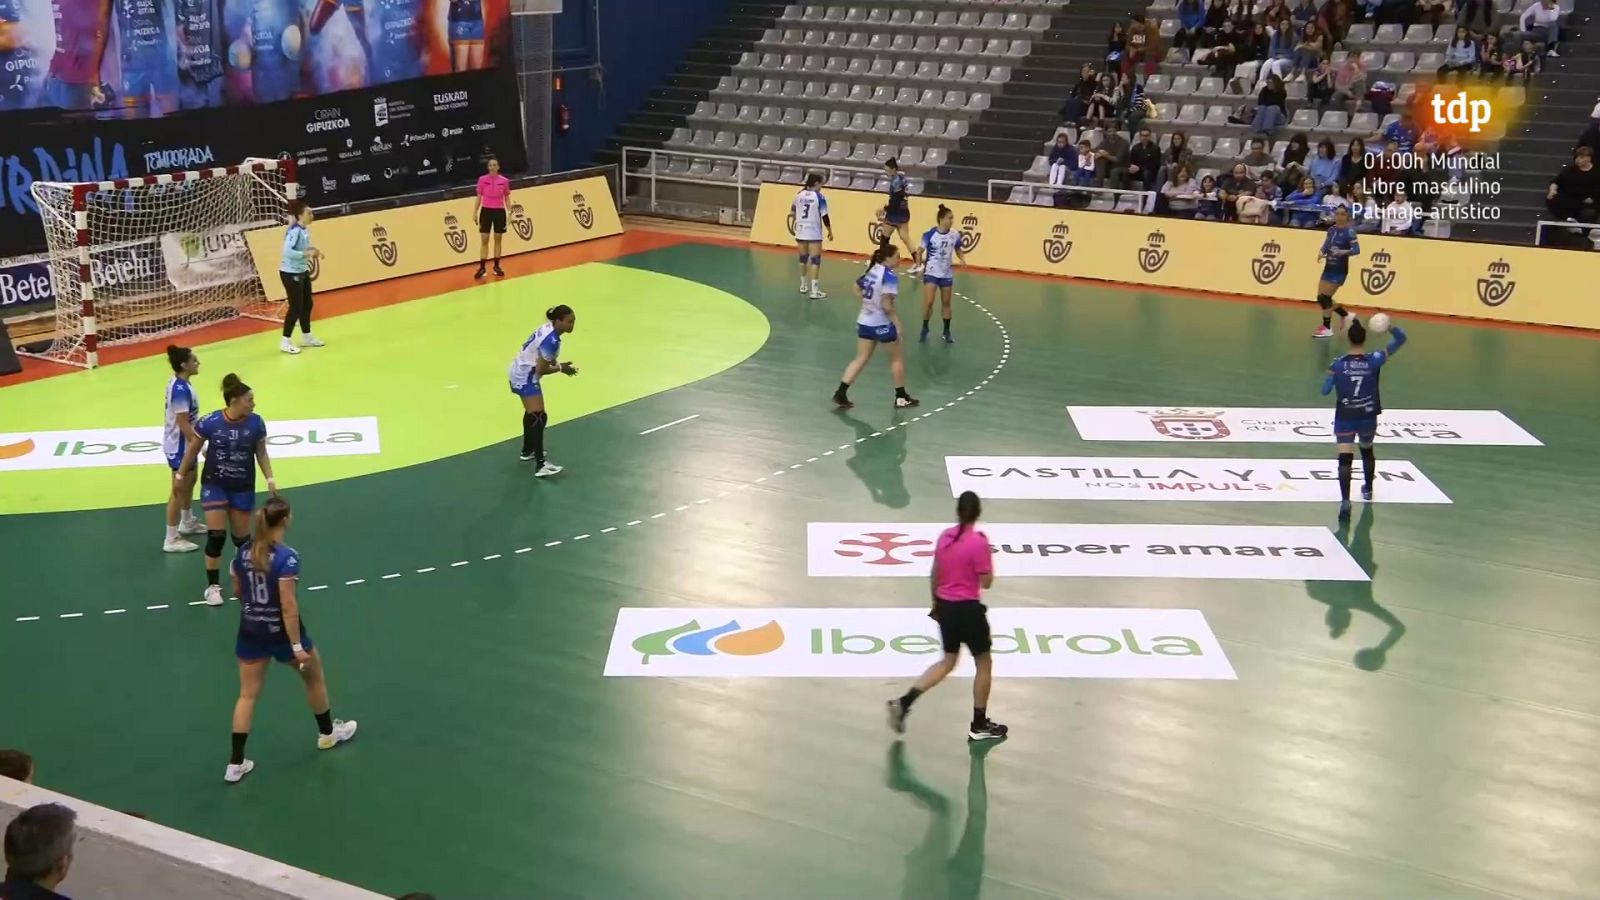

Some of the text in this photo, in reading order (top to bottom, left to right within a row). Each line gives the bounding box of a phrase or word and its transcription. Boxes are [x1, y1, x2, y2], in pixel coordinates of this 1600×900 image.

[433, 90, 468, 105] EUSKADI
[306, 118, 351, 133] GIPUZKOA
[144, 145, 215, 173] TEMPORADA
[801, 203, 810, 219] 3
[90, 249, 153, 289] Betelu
[0, 264, 58, 305] Betel
[1350, 375, 1364, 397] 7
[228, 429, 239, 440] 31
[1293, 425, 1463, 439] Cuta
[53, 429, 363, 457] Ibeola
[961, 467, 1200, 480] CASTILLA
[1224, 468, 1254, 482] Y
[1146, 543, 1325, 558] amara
[247, 570, 269, 605] 18
[810, 627, 1204, 658] Ibedrola
